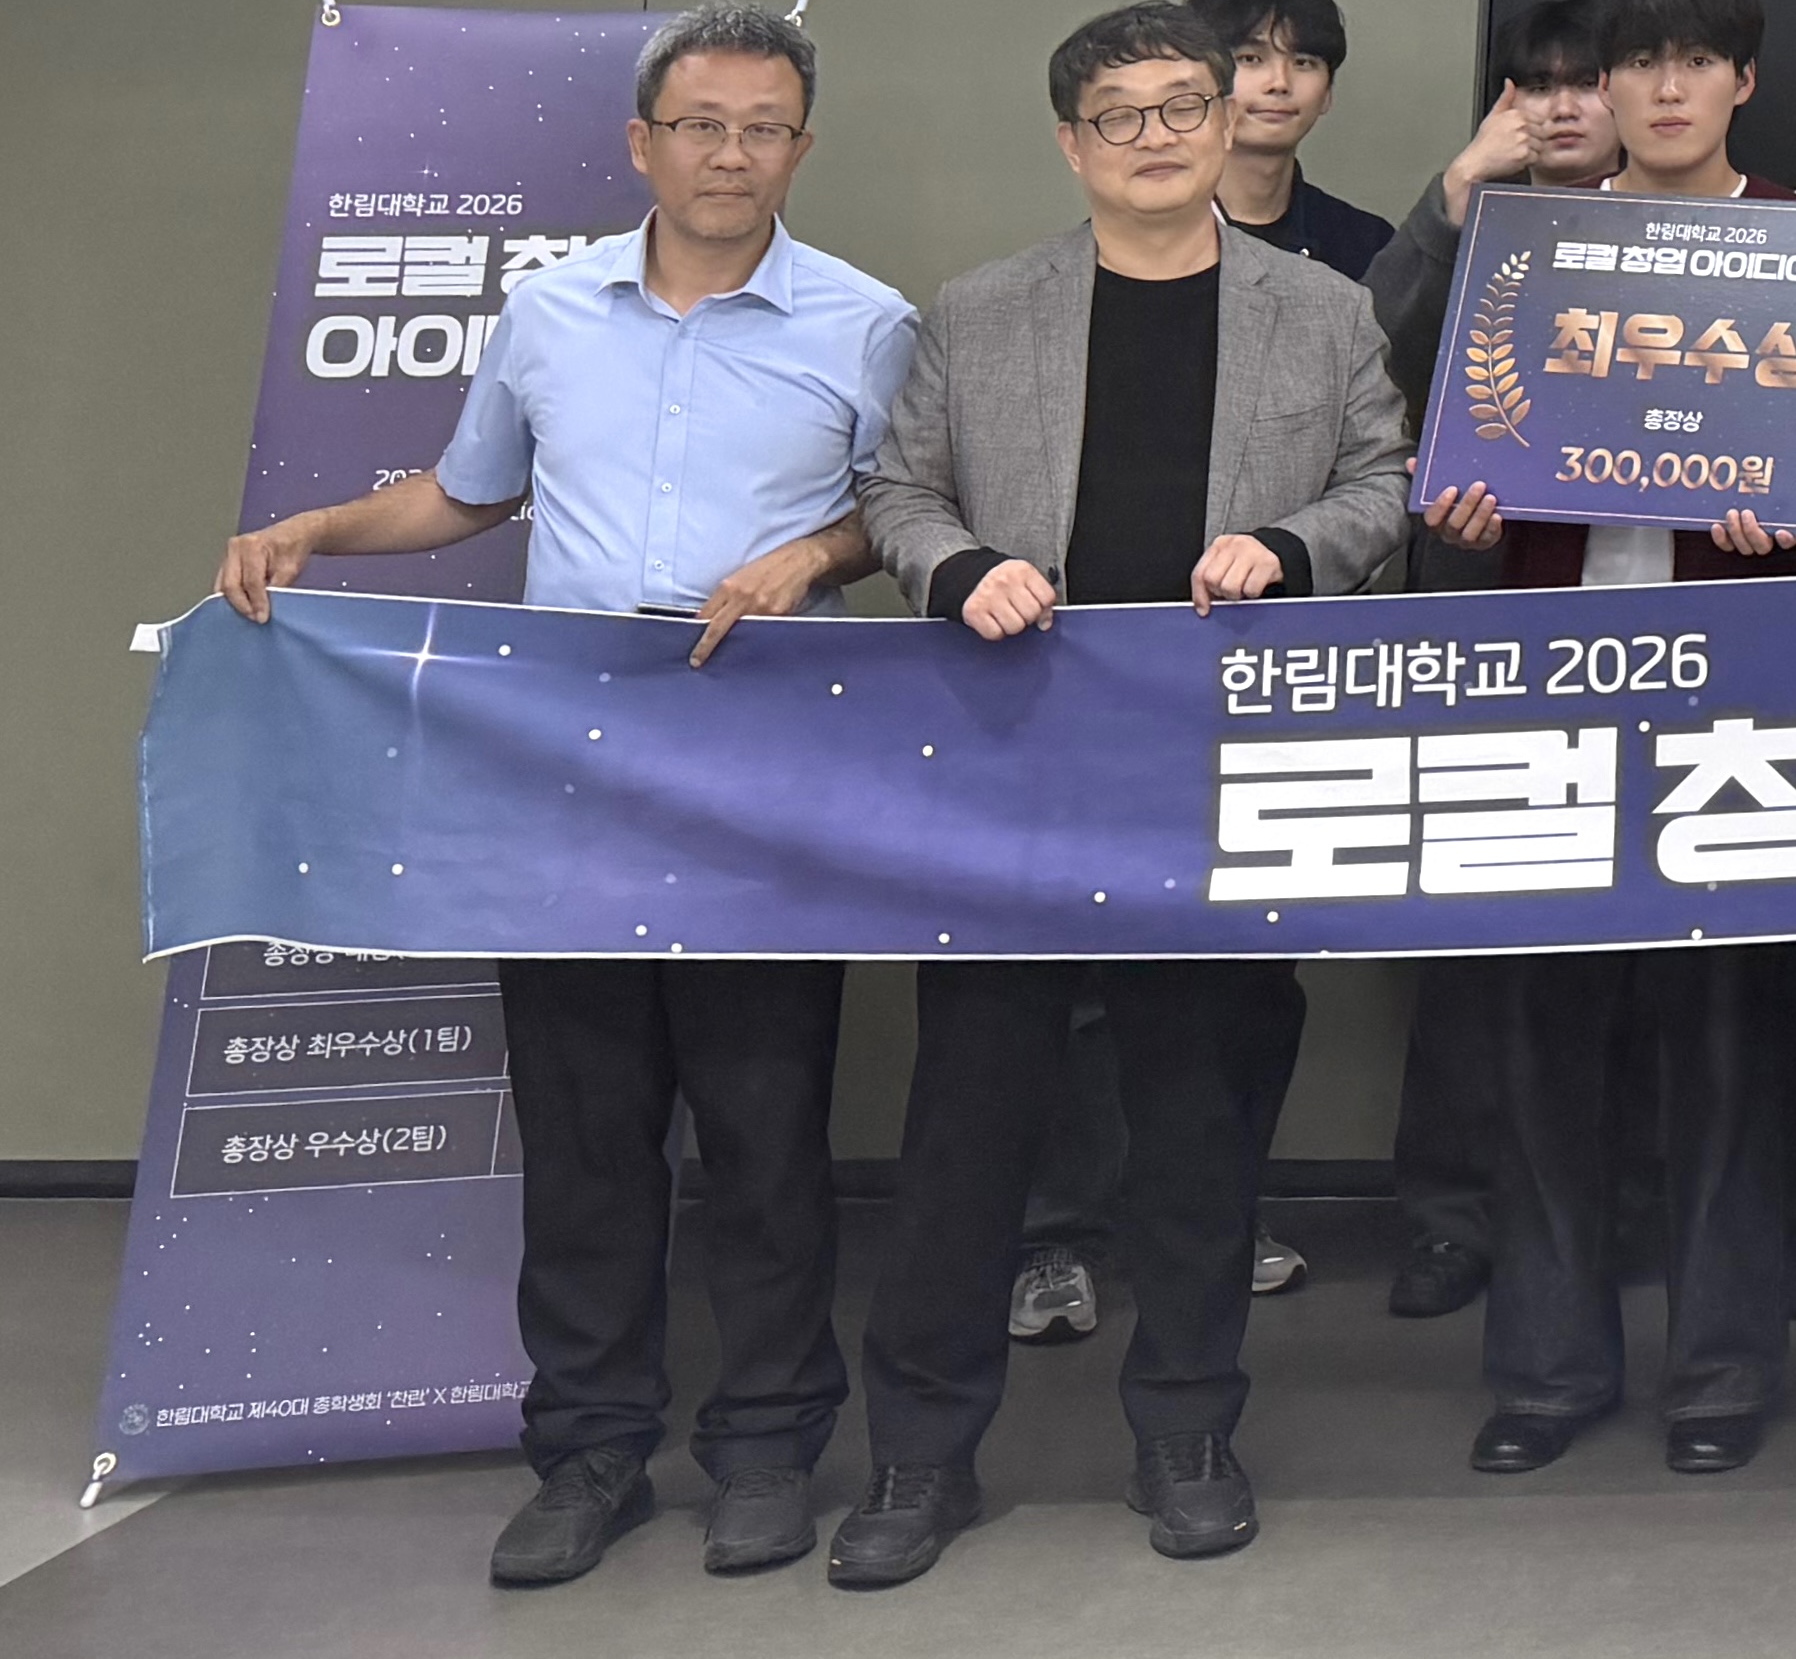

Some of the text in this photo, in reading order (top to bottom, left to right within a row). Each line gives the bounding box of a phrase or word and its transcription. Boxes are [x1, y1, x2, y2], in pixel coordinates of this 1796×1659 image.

[329, 193, 523, 217] 한림대학교 2026
[1645, 222, 1767, 244] 한림대학교 2026
[315, 236, 490, 297] 로컬
[1553, 242, 1618, 273] 로컬
[1621, 246, 1688, 276] 창업
[1644, 408, 1703, 432] 총장상
[1555, 446, 1774, 494] 300,000원
[1221, 632, 1708, 715] 한림대학교 2026
[1209, 727, 1617, 901] 로컬
[224, 1026, 472, 1064] 총장상 최우수상(1팀)
[221, 1125, 447, 1163] 총장상 우수상(2팀)
[156, 1404, 244, 1427] 한림대학교
[247, 1398, 309, 1418] 제40대
[312, 1392, 381, 1414] 총학생회
[432, 1388, 447, 1405] X
